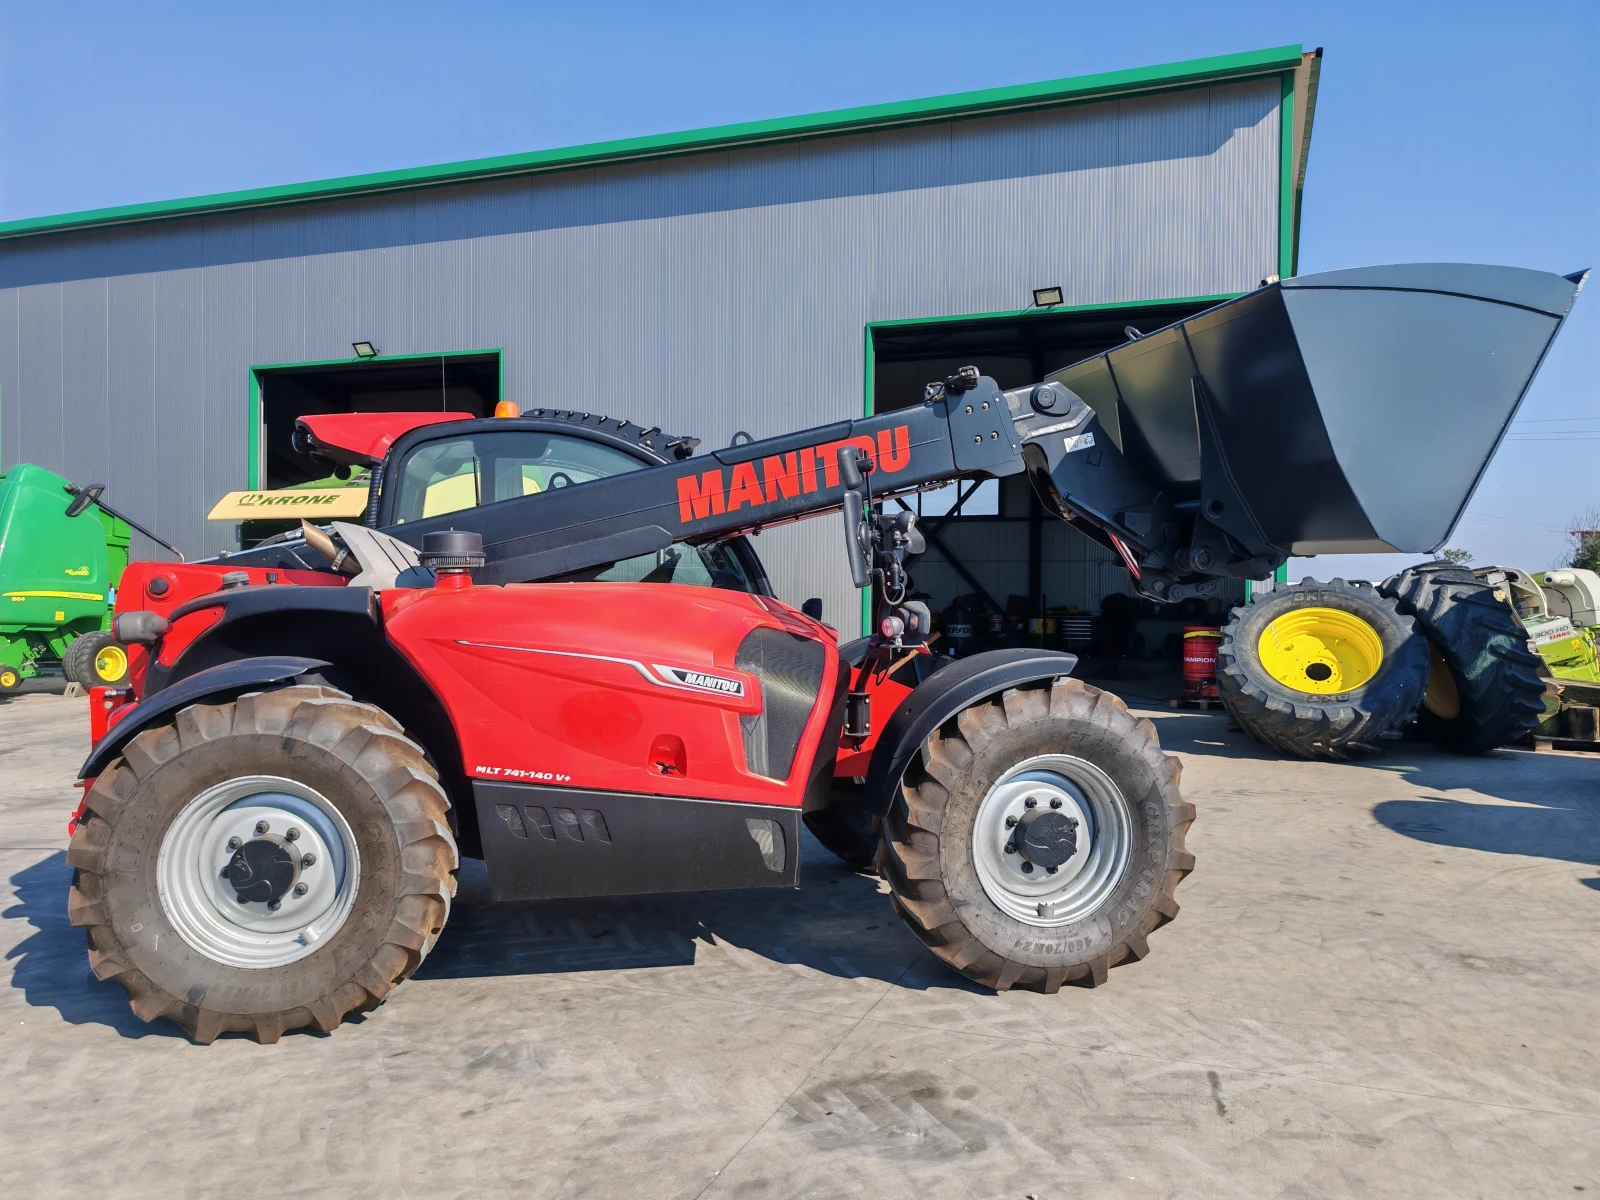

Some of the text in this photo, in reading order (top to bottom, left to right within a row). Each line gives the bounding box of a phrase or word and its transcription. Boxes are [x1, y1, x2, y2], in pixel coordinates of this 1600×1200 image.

[676, 425, 911, 523] MANITOU
[259, 494, 342, 506] KRONE
[684, 672, 739, 692] MANITOU
[475, 765, 572, 782] MLT 741-140 V+
